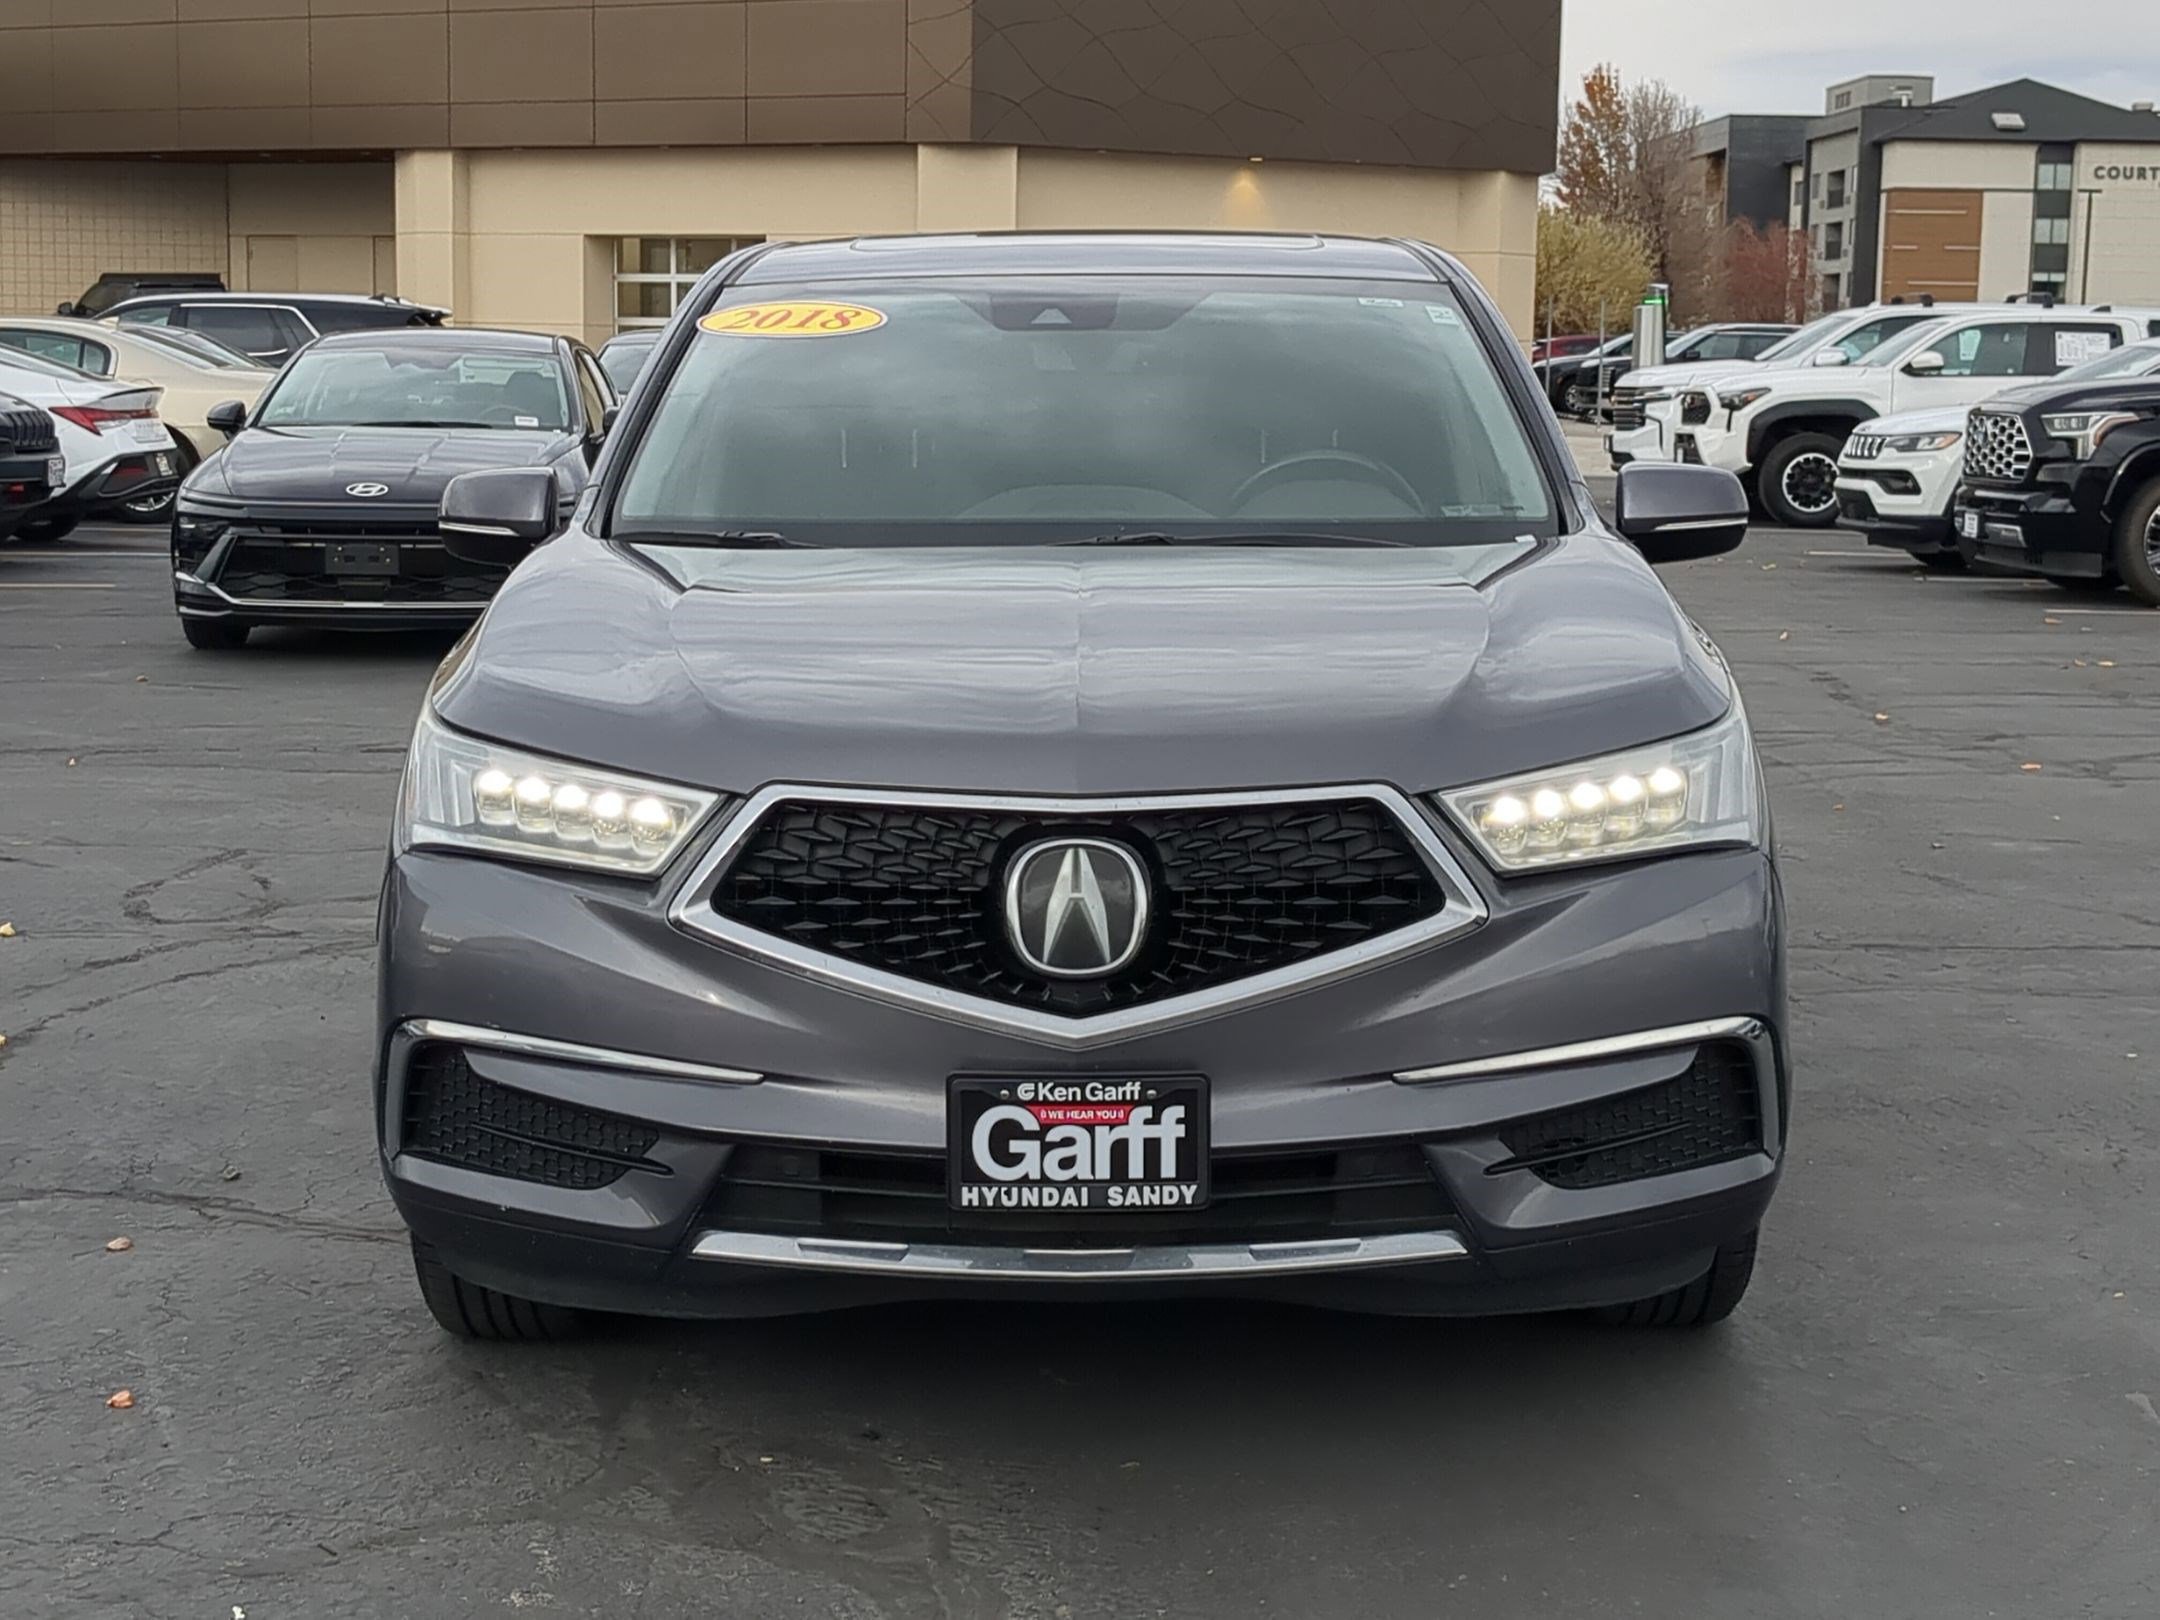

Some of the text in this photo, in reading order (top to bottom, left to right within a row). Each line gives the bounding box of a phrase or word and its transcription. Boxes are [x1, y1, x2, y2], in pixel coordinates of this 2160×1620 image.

[2094, 165, 2160, 180] COURT
[719, 308, 862, 330] 2018
[1038, 1081, 1141, 1101] Ken Garff
[1048, 1109, 1117, 1120] WE HEAR YOU
[971, 1104, 1186, 1182] Garff
[961, 1184, 1198, 1207] HYUNDAI SANDY
